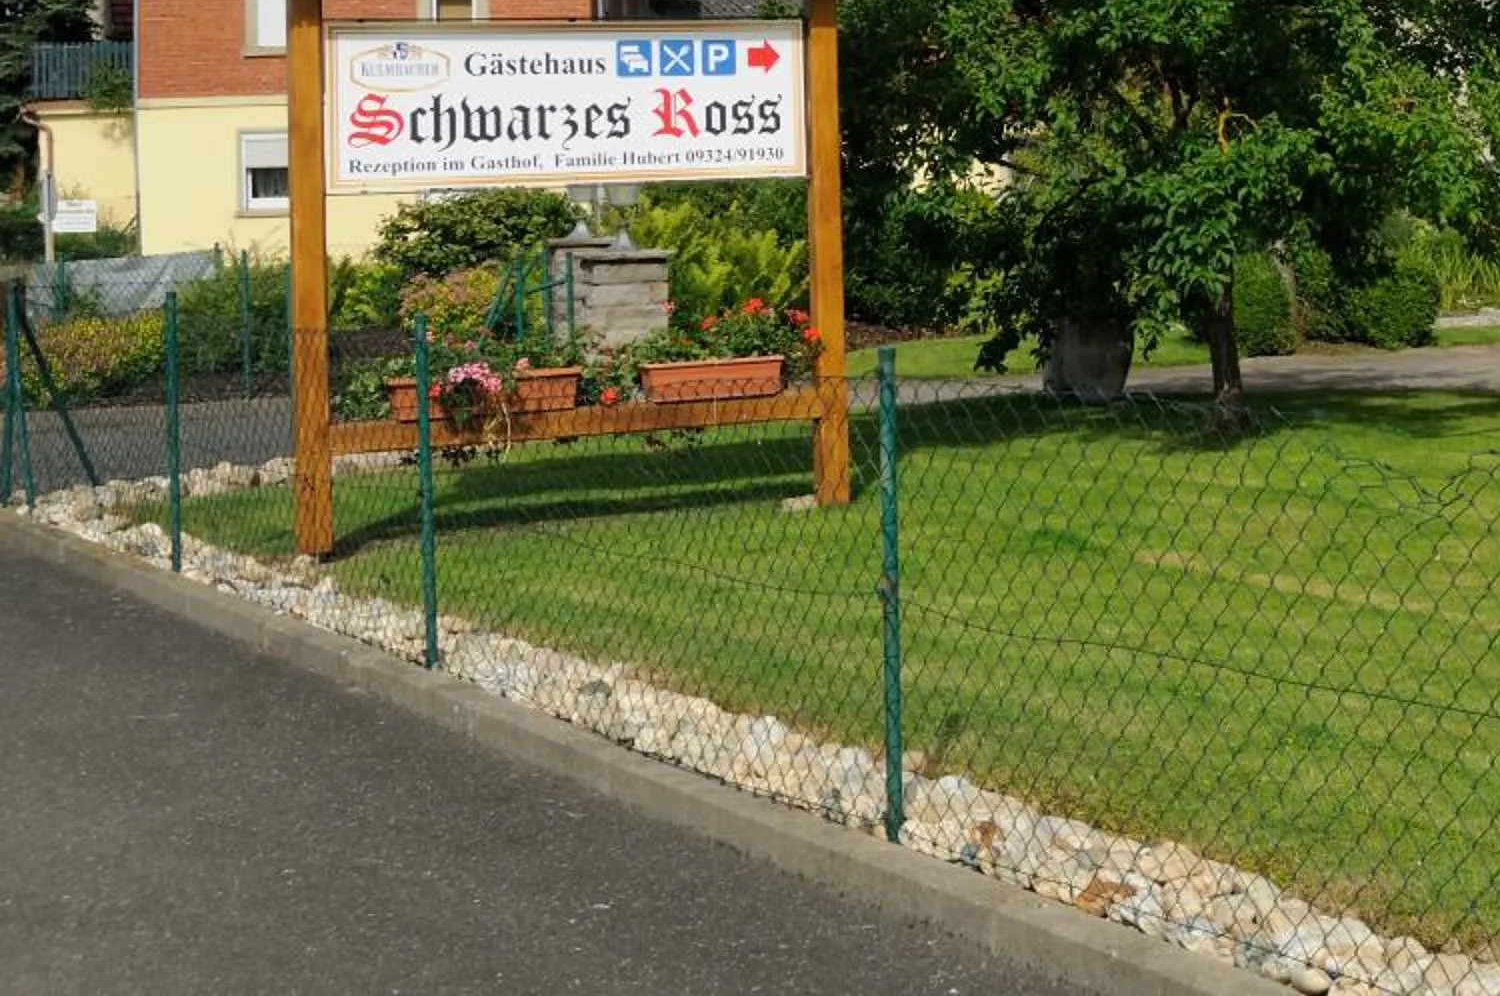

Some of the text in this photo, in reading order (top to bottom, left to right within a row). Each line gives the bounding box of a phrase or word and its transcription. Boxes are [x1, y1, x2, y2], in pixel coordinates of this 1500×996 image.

[463, 50, 607, 77] Gästehaus
[707, 44, 729, 72] P
[347, 87, 783, 151] Schwarzes Ross
[349, 158, 437, 176] Rezeption
[443, 157, 465, 172] im
[555, 153, 615, 168] Familie
[622, 151, 680, 166] Hubert
